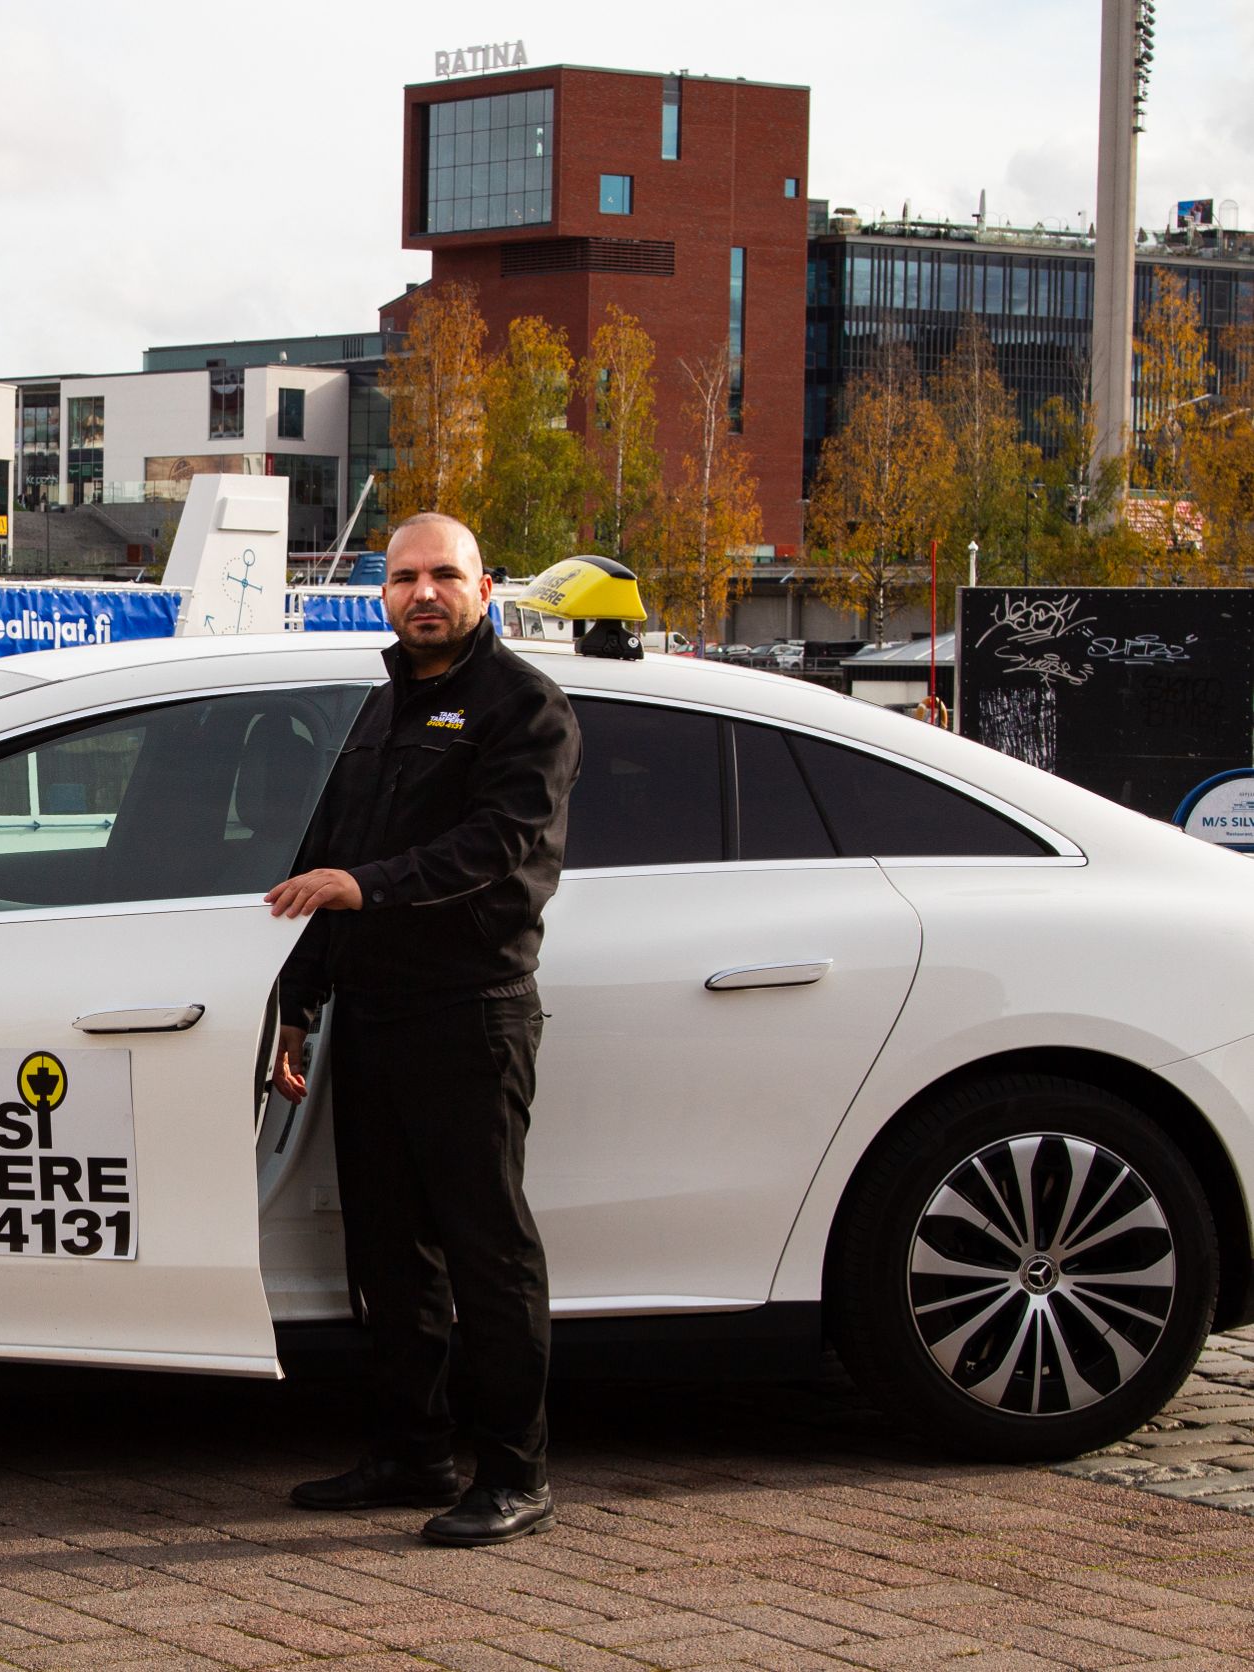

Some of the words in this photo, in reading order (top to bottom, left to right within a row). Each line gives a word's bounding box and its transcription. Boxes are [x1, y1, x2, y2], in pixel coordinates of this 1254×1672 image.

[435, 39, 528, 77] RATINA
[430, 715, 466, 725] TAMPERE
[445, 722, 464, 730] 4131
[1202, 817, 1227, 827] M/S
